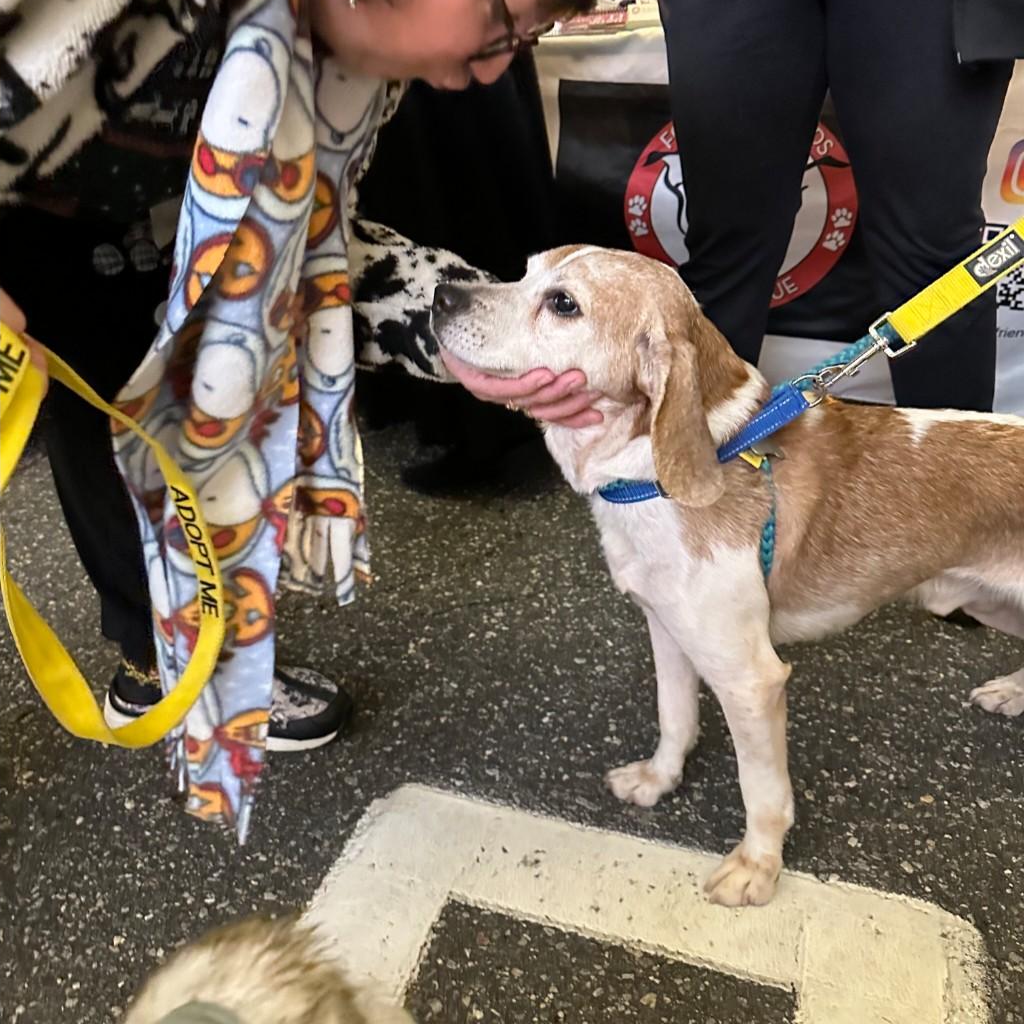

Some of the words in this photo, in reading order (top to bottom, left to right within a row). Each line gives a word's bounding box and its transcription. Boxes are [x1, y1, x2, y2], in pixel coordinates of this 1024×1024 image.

[974, 235, 1021, 278] dexil
[171, 485, 215, 580] ADOPT
[200, 579, 220, 619] ME
